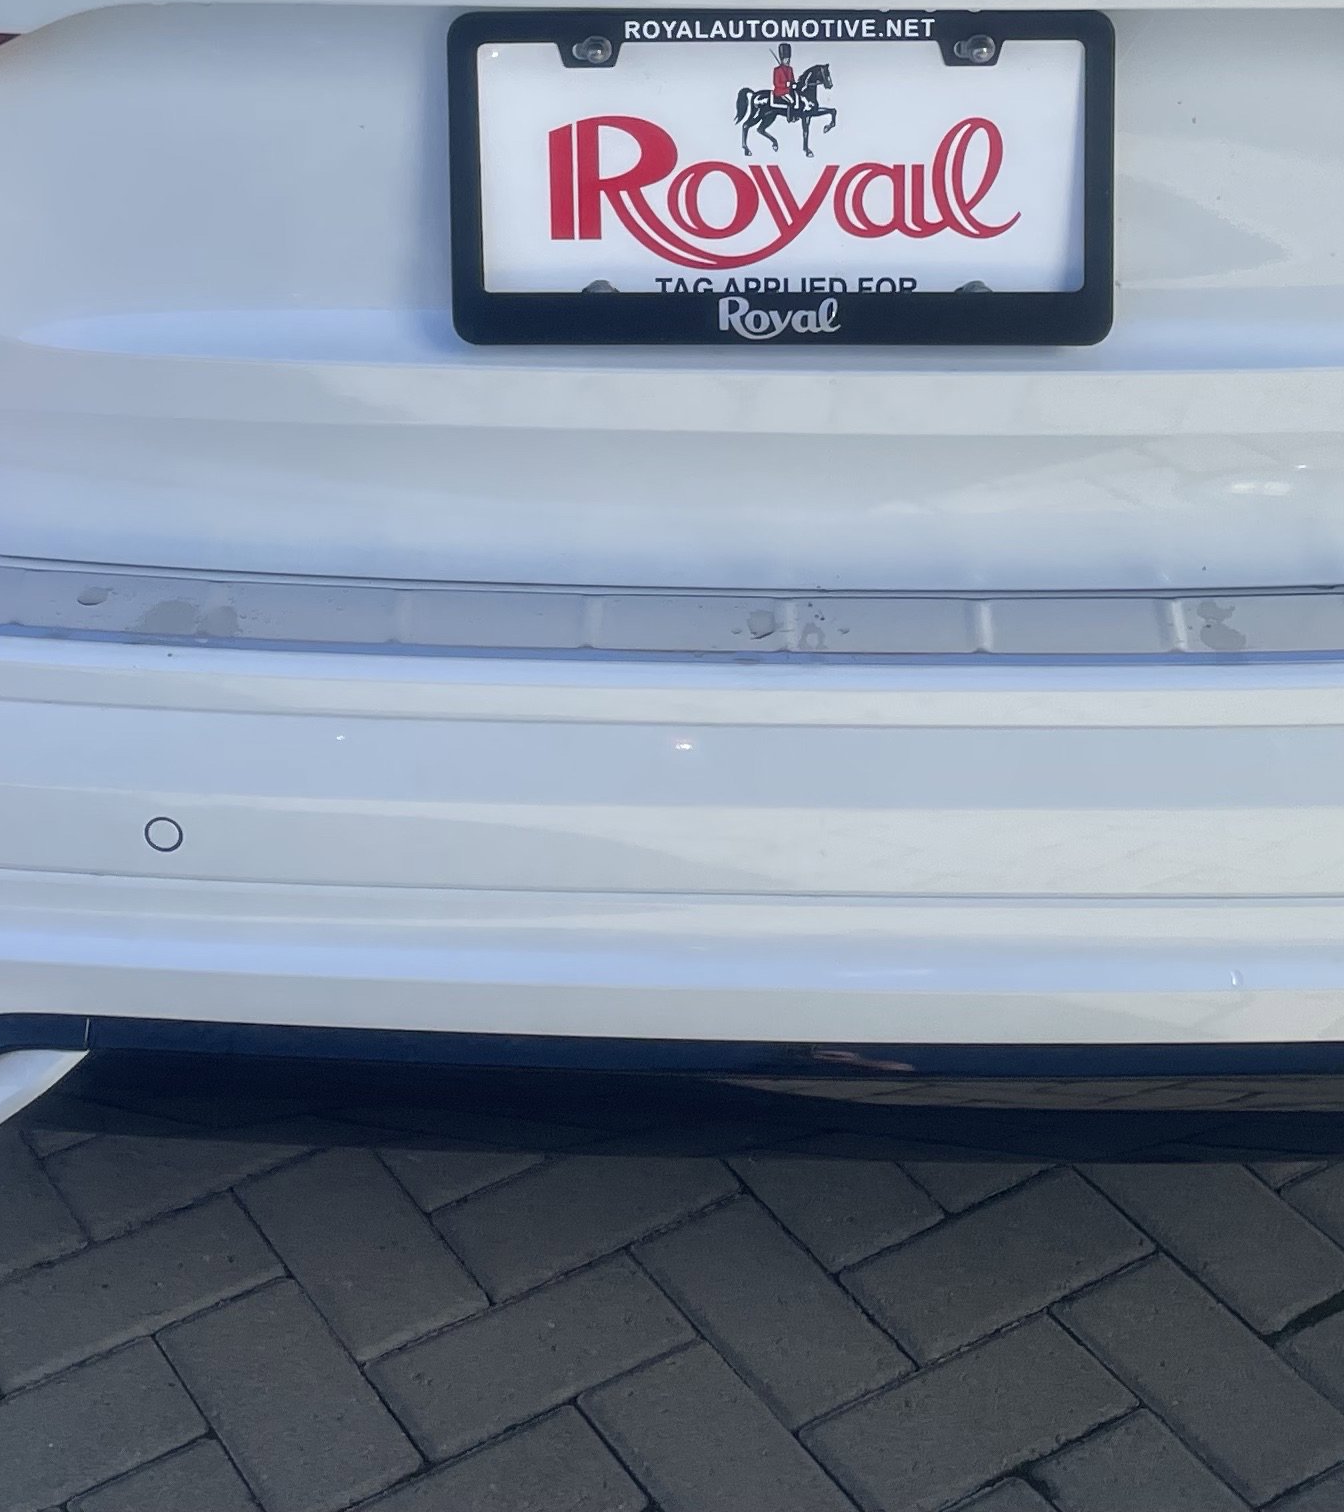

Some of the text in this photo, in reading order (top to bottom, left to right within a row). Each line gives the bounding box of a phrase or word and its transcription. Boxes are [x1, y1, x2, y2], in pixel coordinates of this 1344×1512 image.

[624, 18, 936, 39] ROYALAUTOMOTIVE.NET
[548, 115, 1022, 270] Royal
[655, 277, 918, 293] TAG APPLIED FOR
[718, 296, 841, 340] Royal
